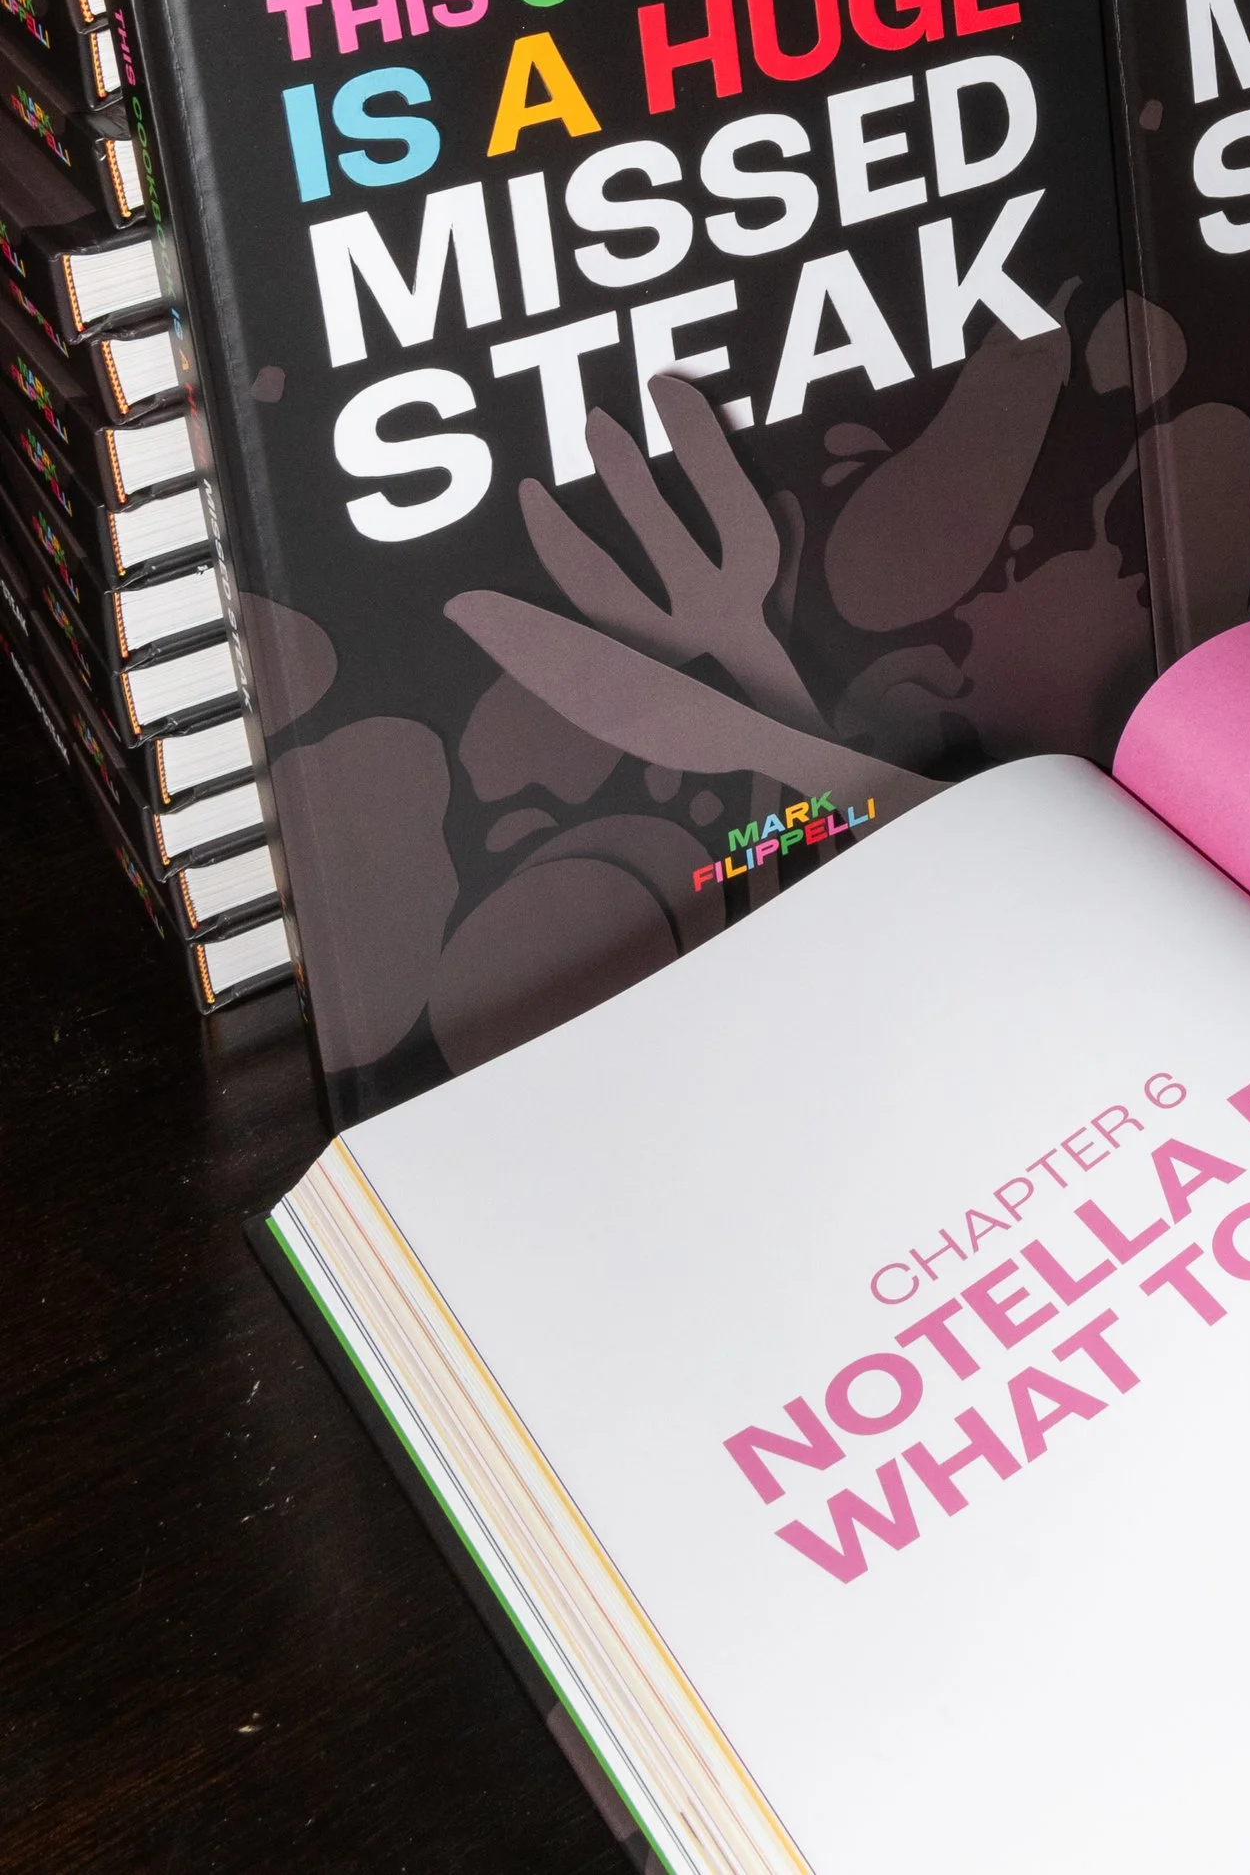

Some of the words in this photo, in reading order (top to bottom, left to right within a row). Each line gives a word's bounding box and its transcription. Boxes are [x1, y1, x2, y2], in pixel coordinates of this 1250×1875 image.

[282, 66, 441, 202] IS
[487, 31, 602, 157] A
[309, 54, 1038, 368] MISSED
[115, 8, 137, 86] THIS
[203, 476, 233, 601] MISSED
[333, 189, 1062, 542] STEAK
[692, 796, 876, 893] FILIPPELLI
[728, 789, 837, 853] MARK
[722, 1137, 1247, 1505] NOTELLA
[870, 1104, 1145, 1305] CHAPTER
[1143, 1072, 1187, 1110] 6
[773, 1307, 1142, 1585] WHAT
